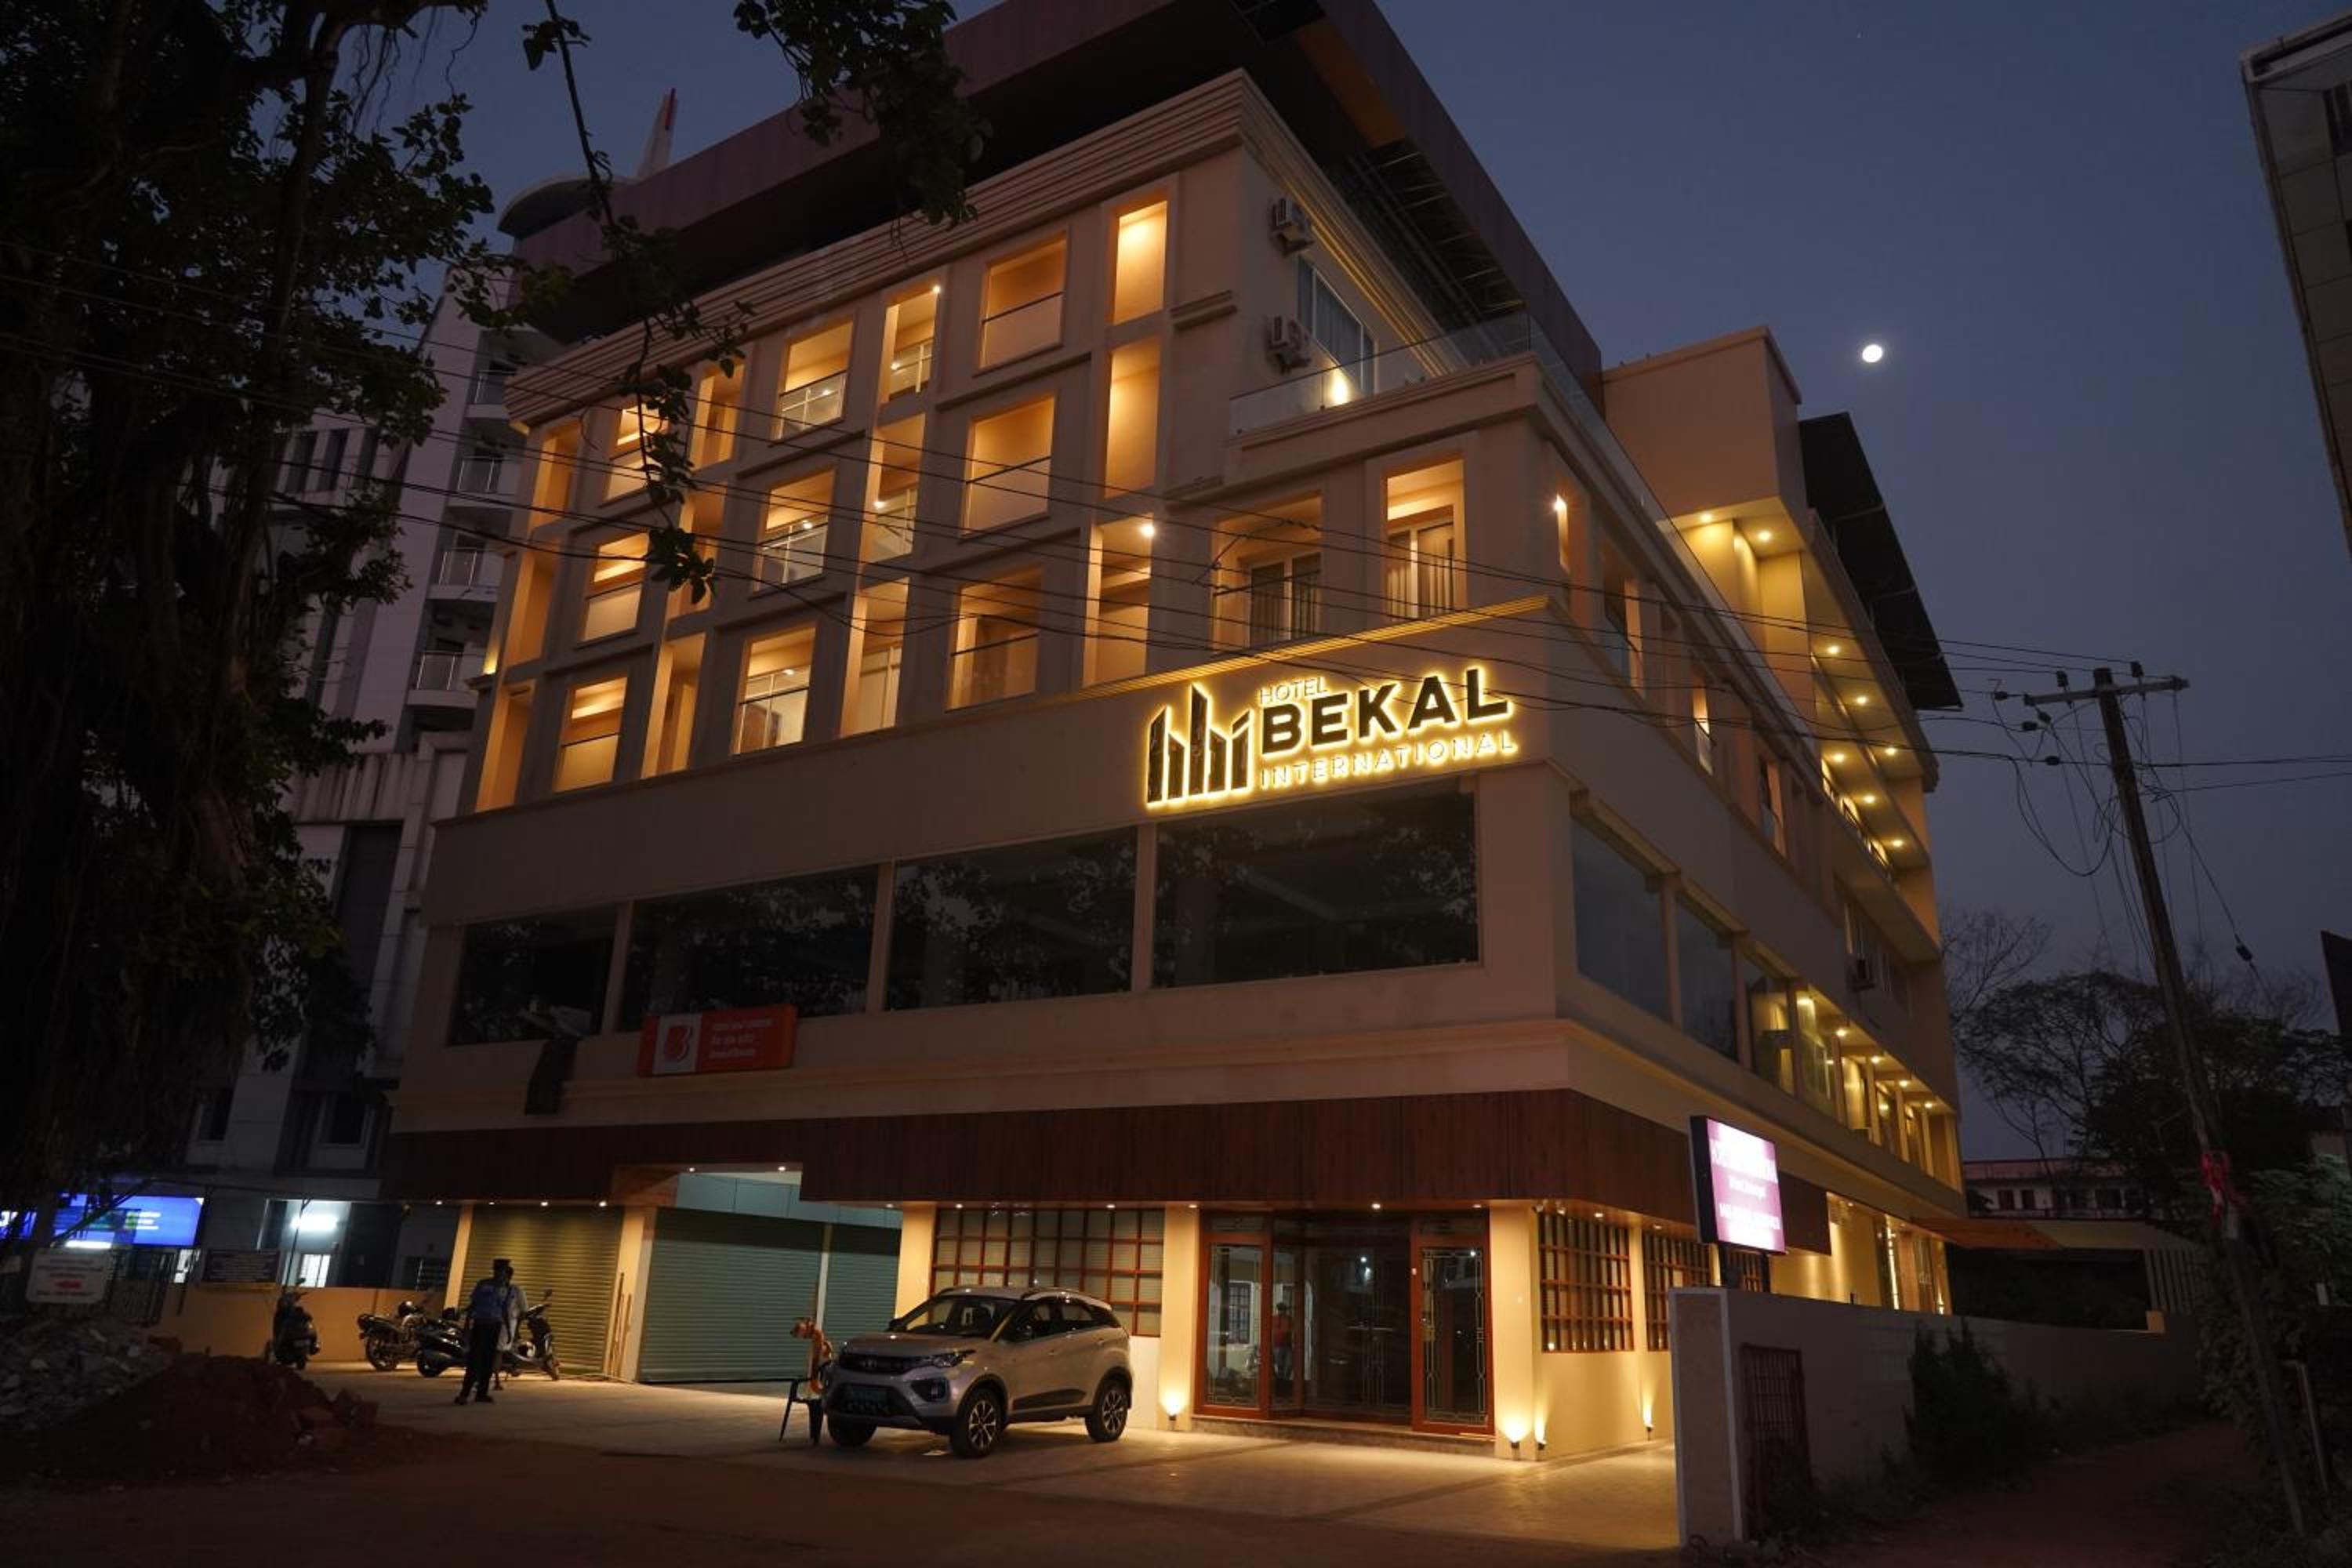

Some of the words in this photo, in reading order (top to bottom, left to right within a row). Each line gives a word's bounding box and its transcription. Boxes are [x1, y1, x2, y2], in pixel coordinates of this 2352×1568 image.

[1260, 677, 1328, 704] HOTEL
[1261, 667, 1509, 755] BEKAL
[1261, 730, 1517, 789] INTERNATIONAL
